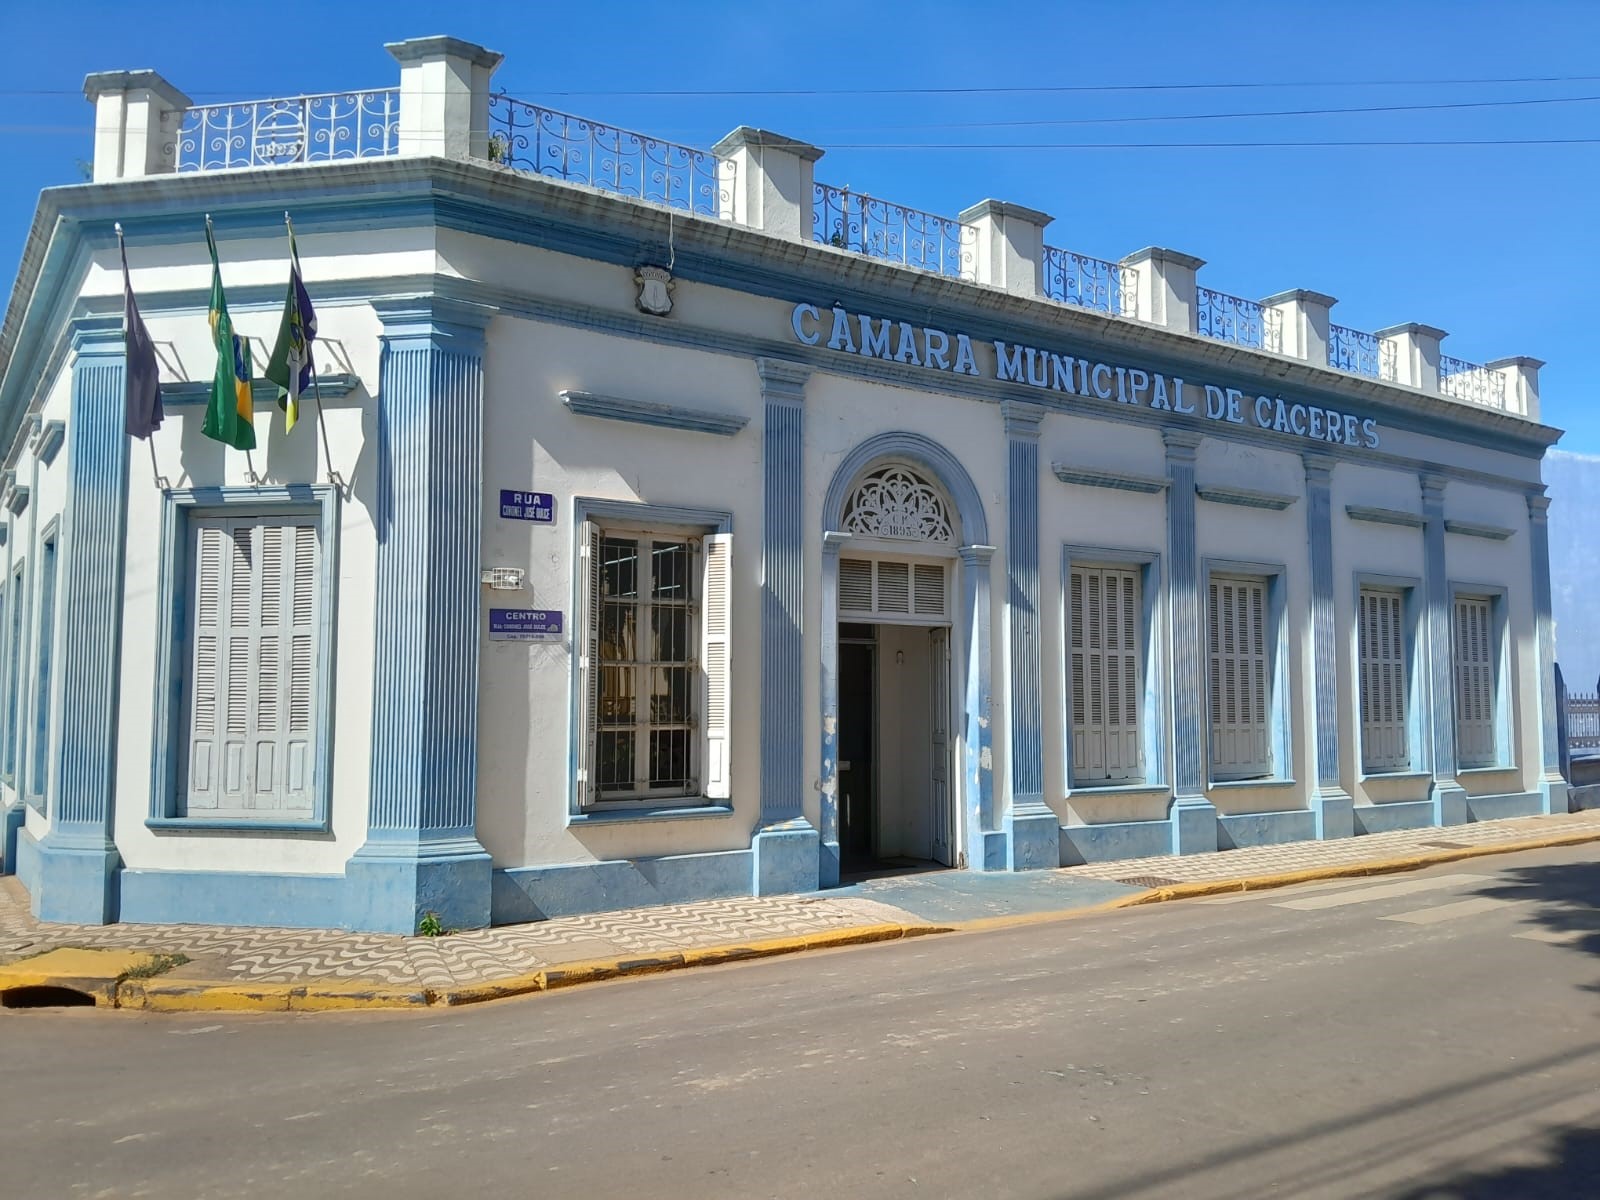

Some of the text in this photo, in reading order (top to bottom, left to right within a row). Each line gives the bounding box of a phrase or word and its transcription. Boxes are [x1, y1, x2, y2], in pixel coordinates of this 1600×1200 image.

[791, 300, 1380, 449] CÂMARA MUNICIPAL DE CÁCERES
[513, 493, 541, 505] RUA
[523, 505, 536, 518] JOSÉ
[505, 612, 547, 621] CENTRO
